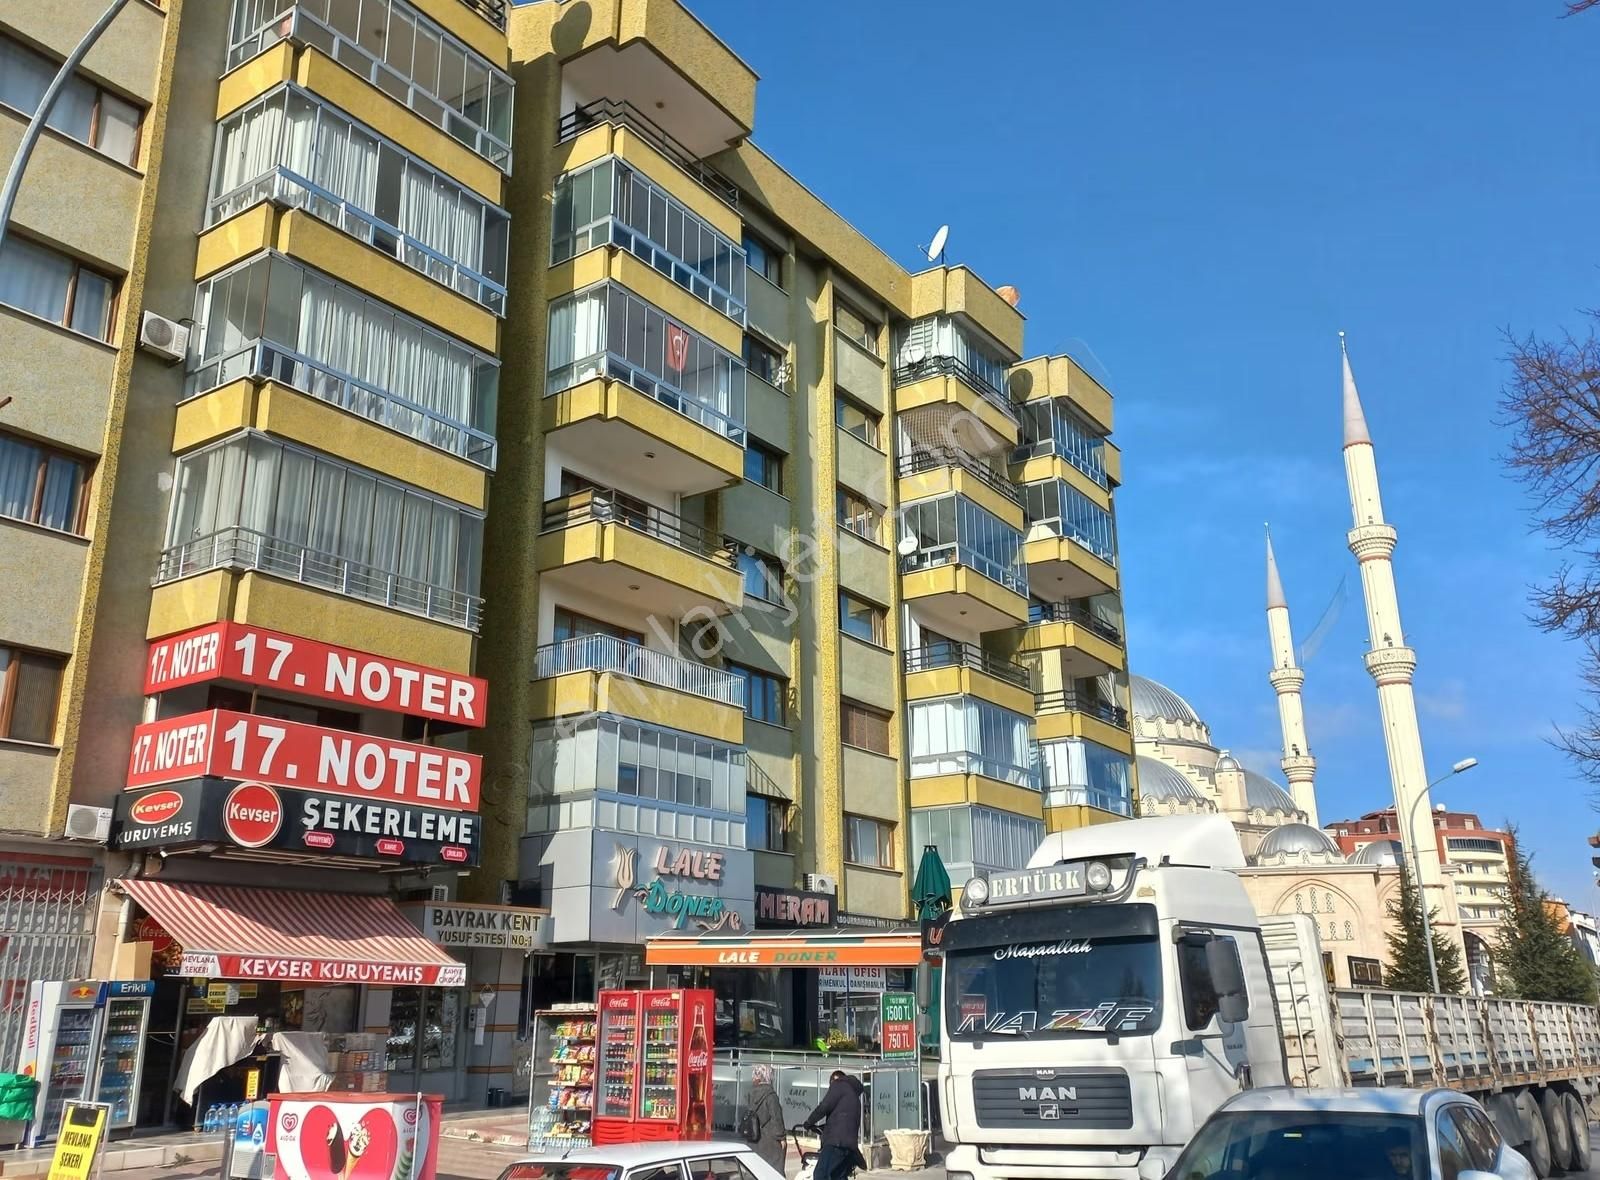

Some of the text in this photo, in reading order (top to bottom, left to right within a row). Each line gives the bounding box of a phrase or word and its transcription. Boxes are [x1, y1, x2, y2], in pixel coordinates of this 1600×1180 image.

[151, 632, 220, 685] 17. NOTER
[235, 632, 475, 720] 17. NOTER
[133, 724, 208, 775] 17. NOTER
[224, 720, 472, 804] 17. NOTER
[135, 800, 180, 814] Kevser
[229, 802, 278, 823] Kevser
[301, 798, 473, 844] ŞEKERLEME
[656, 846, 724, 880] LALE
[991, 868, 1081, 899] ERTÜRK
[760, 892, 830, 925] MERAM
[433, 909, 541, 931] BAYRAK KENT
[438, 929, 473, 943] YUSUF
[182, 955, 216, 964] MEVLANA
[718, 950, 760, 964] LALE
[238, 958, 313, 979] KEVSER
[120, 982, 147, 994] Erikli
[886, 1005, 912, 1021] 1500 TL
[888, 1033, 910, 1049] 750 TL
[1019, 1086, 1077, 1101] MAN
[62, 1131, 93, 1149] MEVLANA
[59, 1152, 83, 1169] ŞEKERİ
